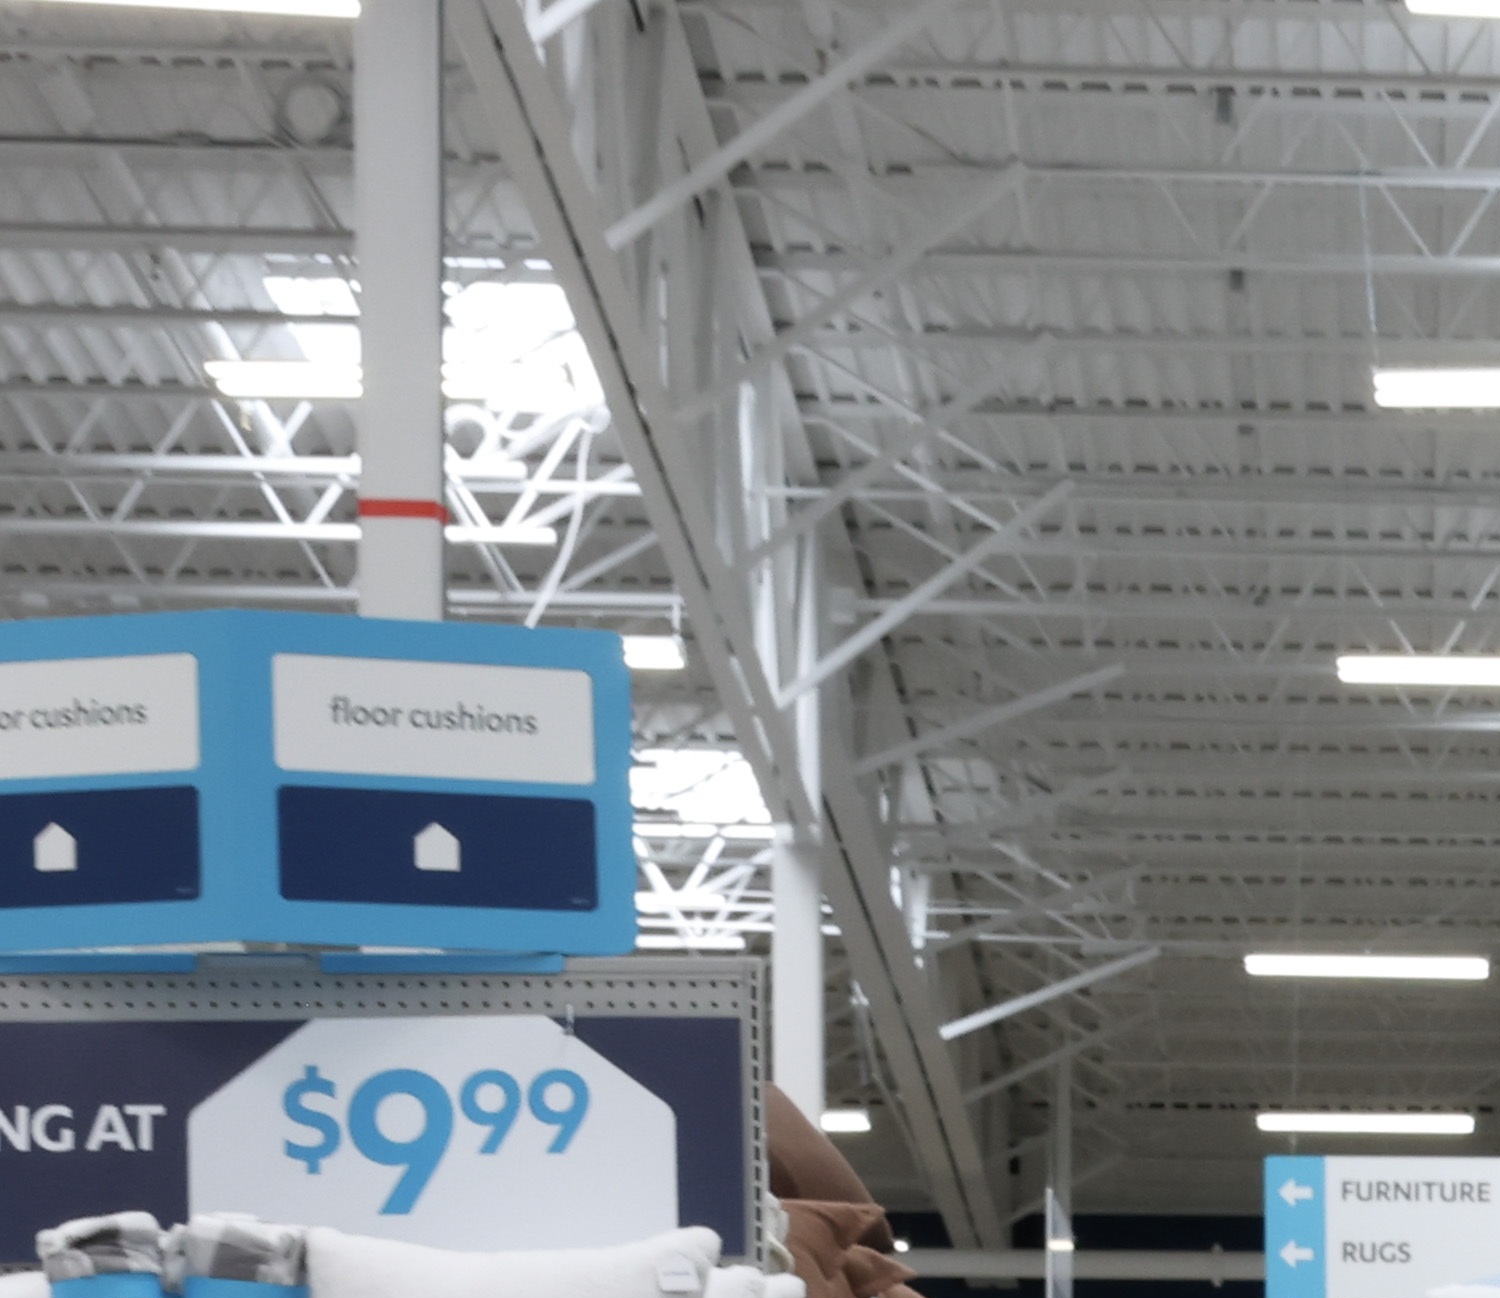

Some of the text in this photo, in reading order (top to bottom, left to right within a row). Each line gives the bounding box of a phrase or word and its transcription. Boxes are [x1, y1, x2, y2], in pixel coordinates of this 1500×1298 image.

[30, 697, 148, 729] cushions
[330, 695, 539, 734] floor cushions
[86, 1104, 166, 1151] AT
[1341, 1180, 1491, 1203] FURNITURE
[1341, 1242, 1411, 1264] RUGS
